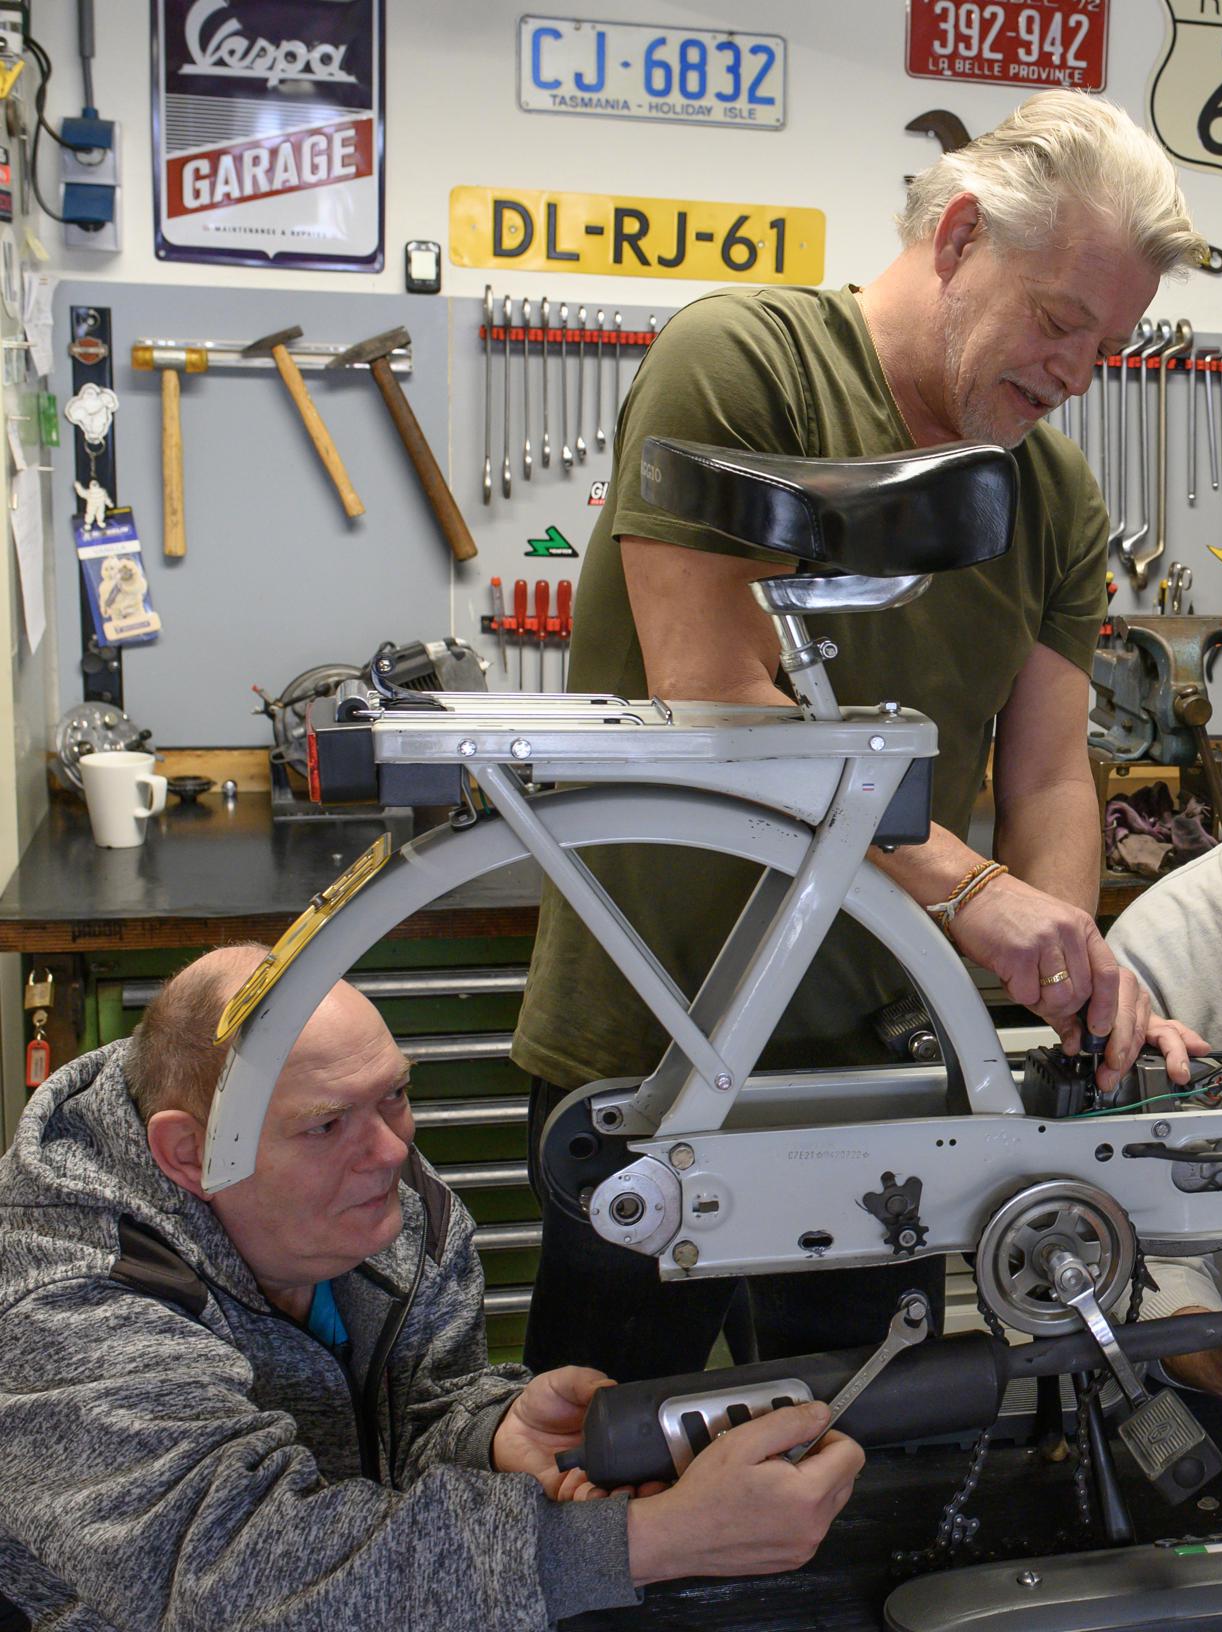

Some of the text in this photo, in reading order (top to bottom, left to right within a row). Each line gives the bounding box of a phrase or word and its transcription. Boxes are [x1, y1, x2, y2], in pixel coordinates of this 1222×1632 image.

[178, 0, 360, 89] Vespa
[932, 1, 1090, 69] 392-942
[928, 57, 1084, 83] LA BELLE PROVINCE
[549, 93, 631, 112] TASMANIA
[648, 102, 714, 118] HOLIDAY
[723, 106, 757, 121] ISLE
[182, 128, 357, 209] GARAGE
[214, 226, 277, 236] MAINTENANCE
[492, 199, 787, 274] DL-RJ-61
